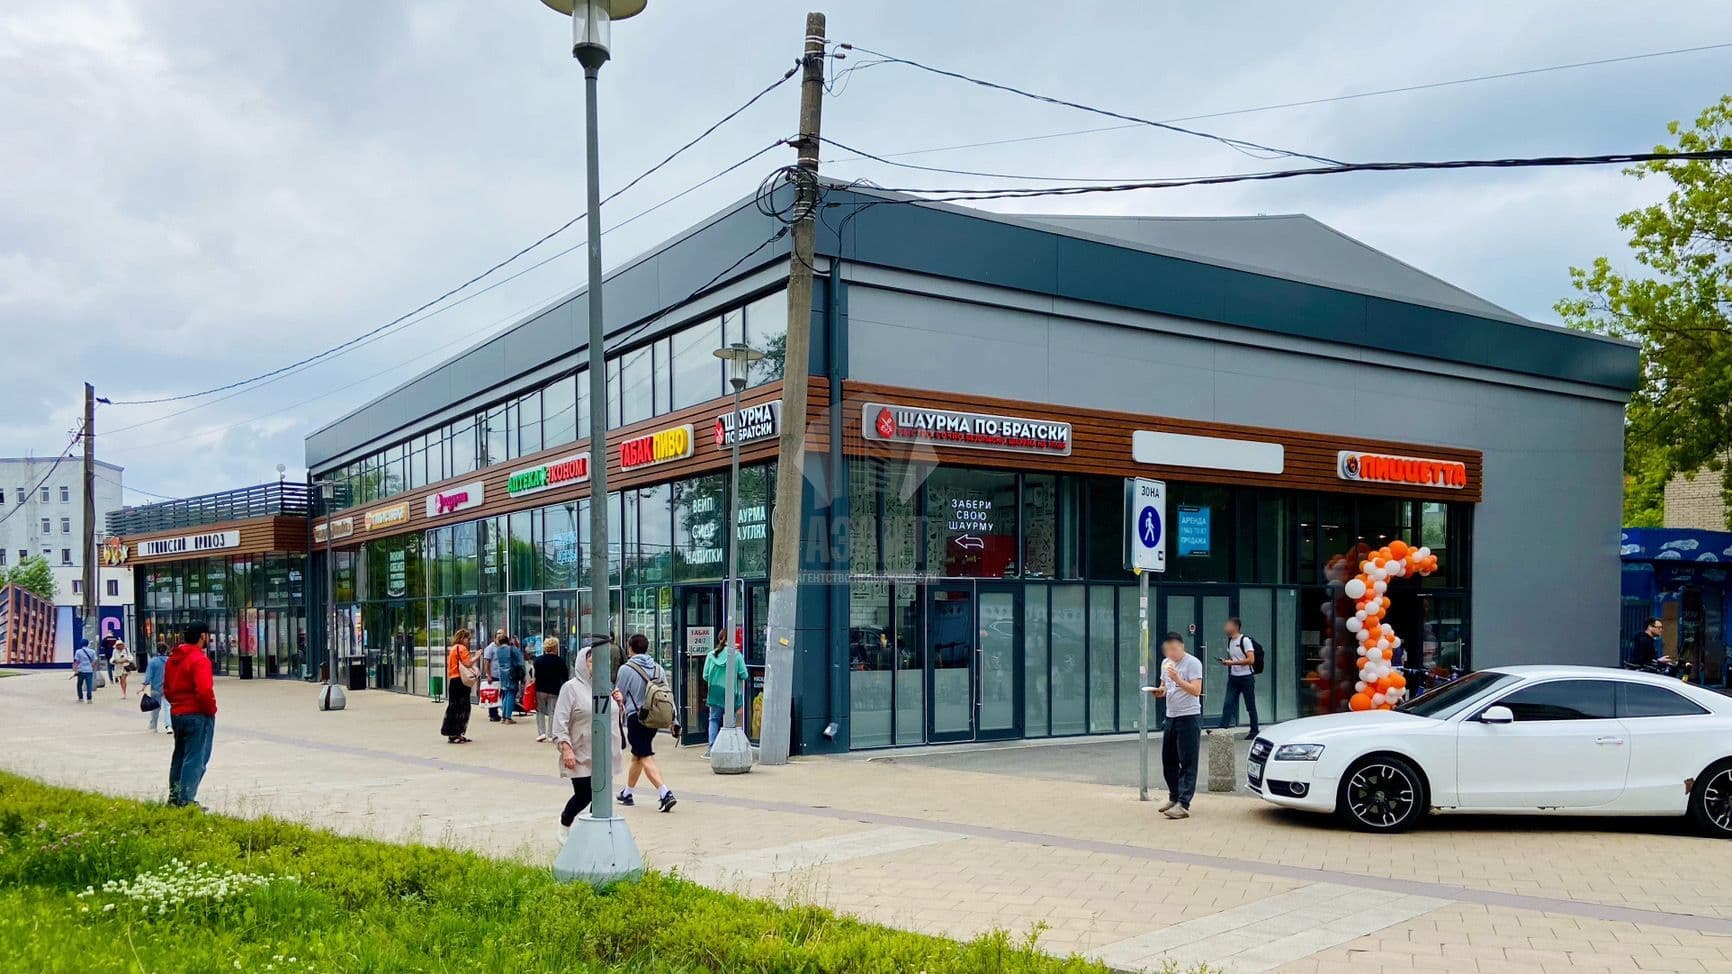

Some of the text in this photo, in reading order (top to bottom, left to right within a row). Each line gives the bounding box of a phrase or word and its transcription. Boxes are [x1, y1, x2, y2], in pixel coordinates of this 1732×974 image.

[899, 411, 1067, 441] ШАУРМА ПО-БРАТСКИ
[621, 429, 687, 467] ТАБАК ПИВО
[1360, 455, 1466, 486] ПИЦЦЕТТА
[1141, 486, 1160, 498] ЗОНА
[693, 497, 713, 513] ВЕЙП
[951, 498, 992, 510] ЗАБЕРИ
[738, 506, 766, 523] АУРМА
[956, 510, 987, 521] СВОЮ
[948, 521, 994, 531] ШАУРМУ
[685, 548, 723, 565] НАПИТКИ
[592, 695, 609, 714] 17
